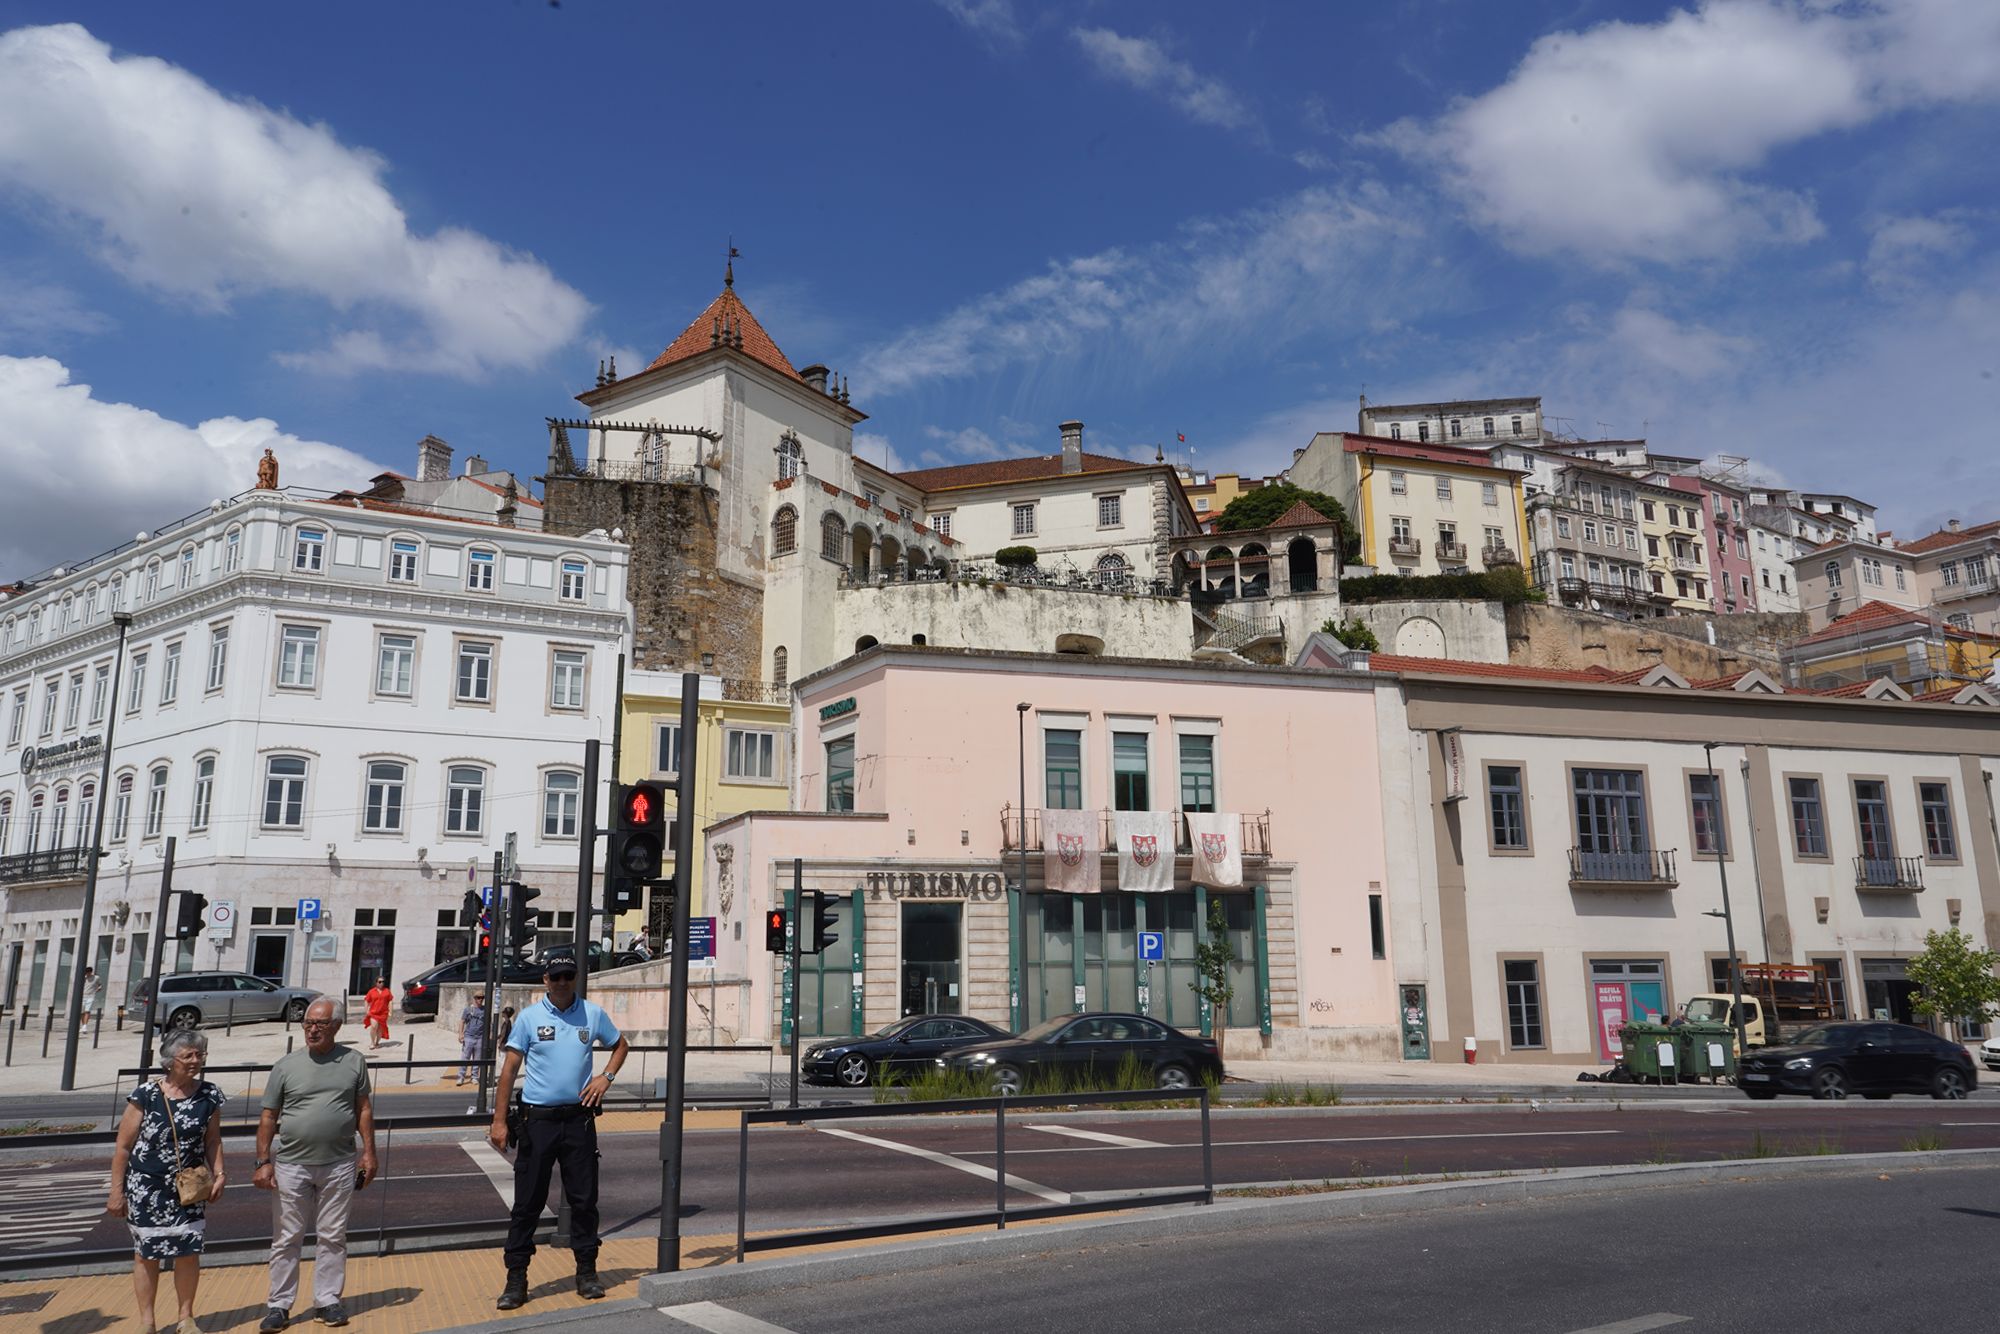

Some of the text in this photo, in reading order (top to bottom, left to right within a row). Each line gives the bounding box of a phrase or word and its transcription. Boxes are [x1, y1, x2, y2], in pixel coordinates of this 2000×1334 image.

[819, 697, 857, 720] TURISMO
[1450, 736, 1458, 758] KING
[866, 872, 1002, 901] TURISMO
[302, 900, 317, 918] P
[1143, 934, 1158, 958] P
[1599, 994, 1623, 1002] GRÁTIS
